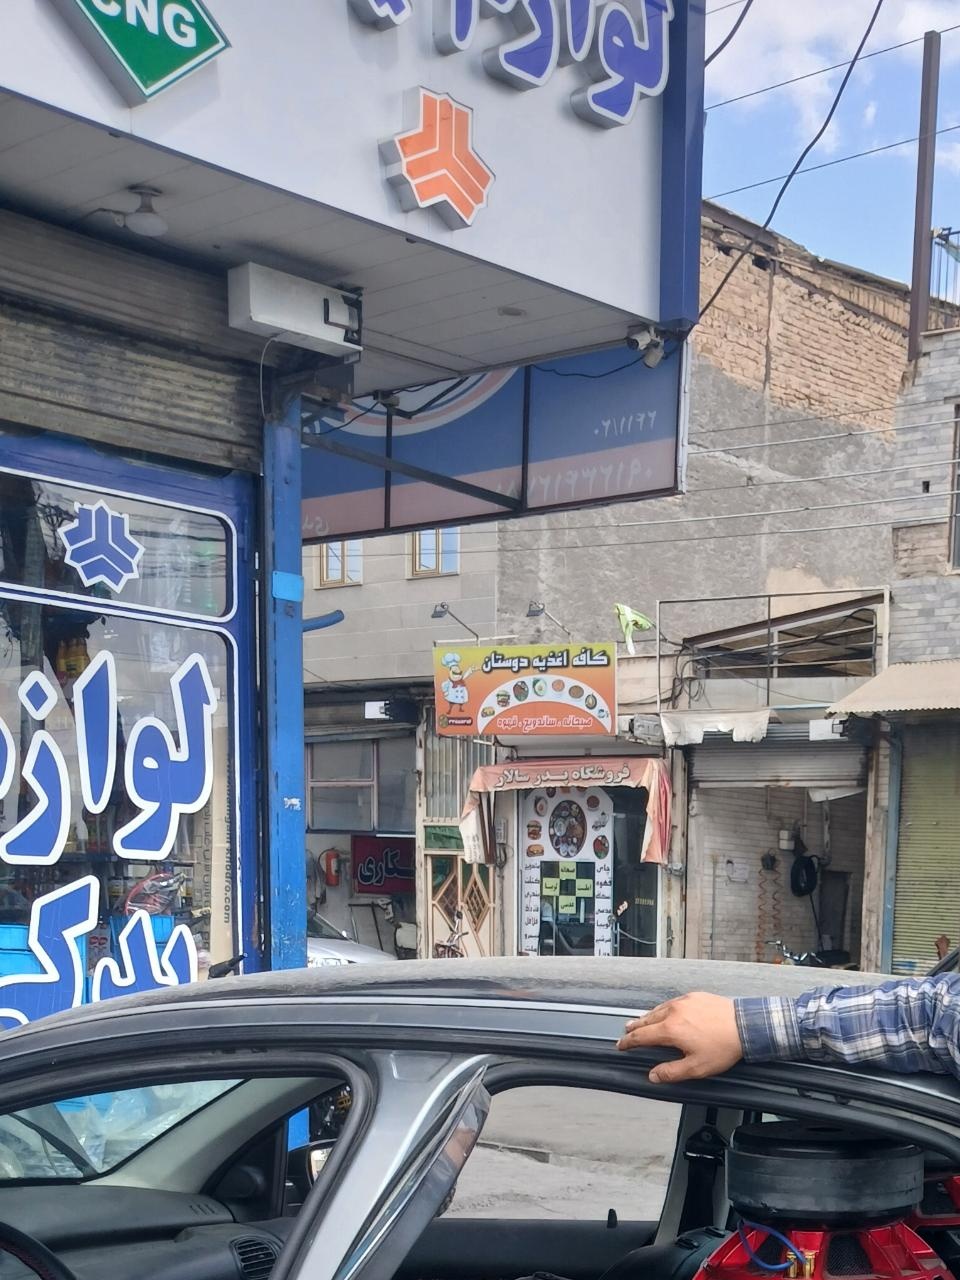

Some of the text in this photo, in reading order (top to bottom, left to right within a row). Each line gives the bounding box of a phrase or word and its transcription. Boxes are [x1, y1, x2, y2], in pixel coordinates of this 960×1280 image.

[482, 647, 610, 673] کافه اغذیه دوستان
[0, 651, 218, 867] لواز
[496, 768, 530, 787] سالار
[572, 763, 631, 783] فروشگاه
